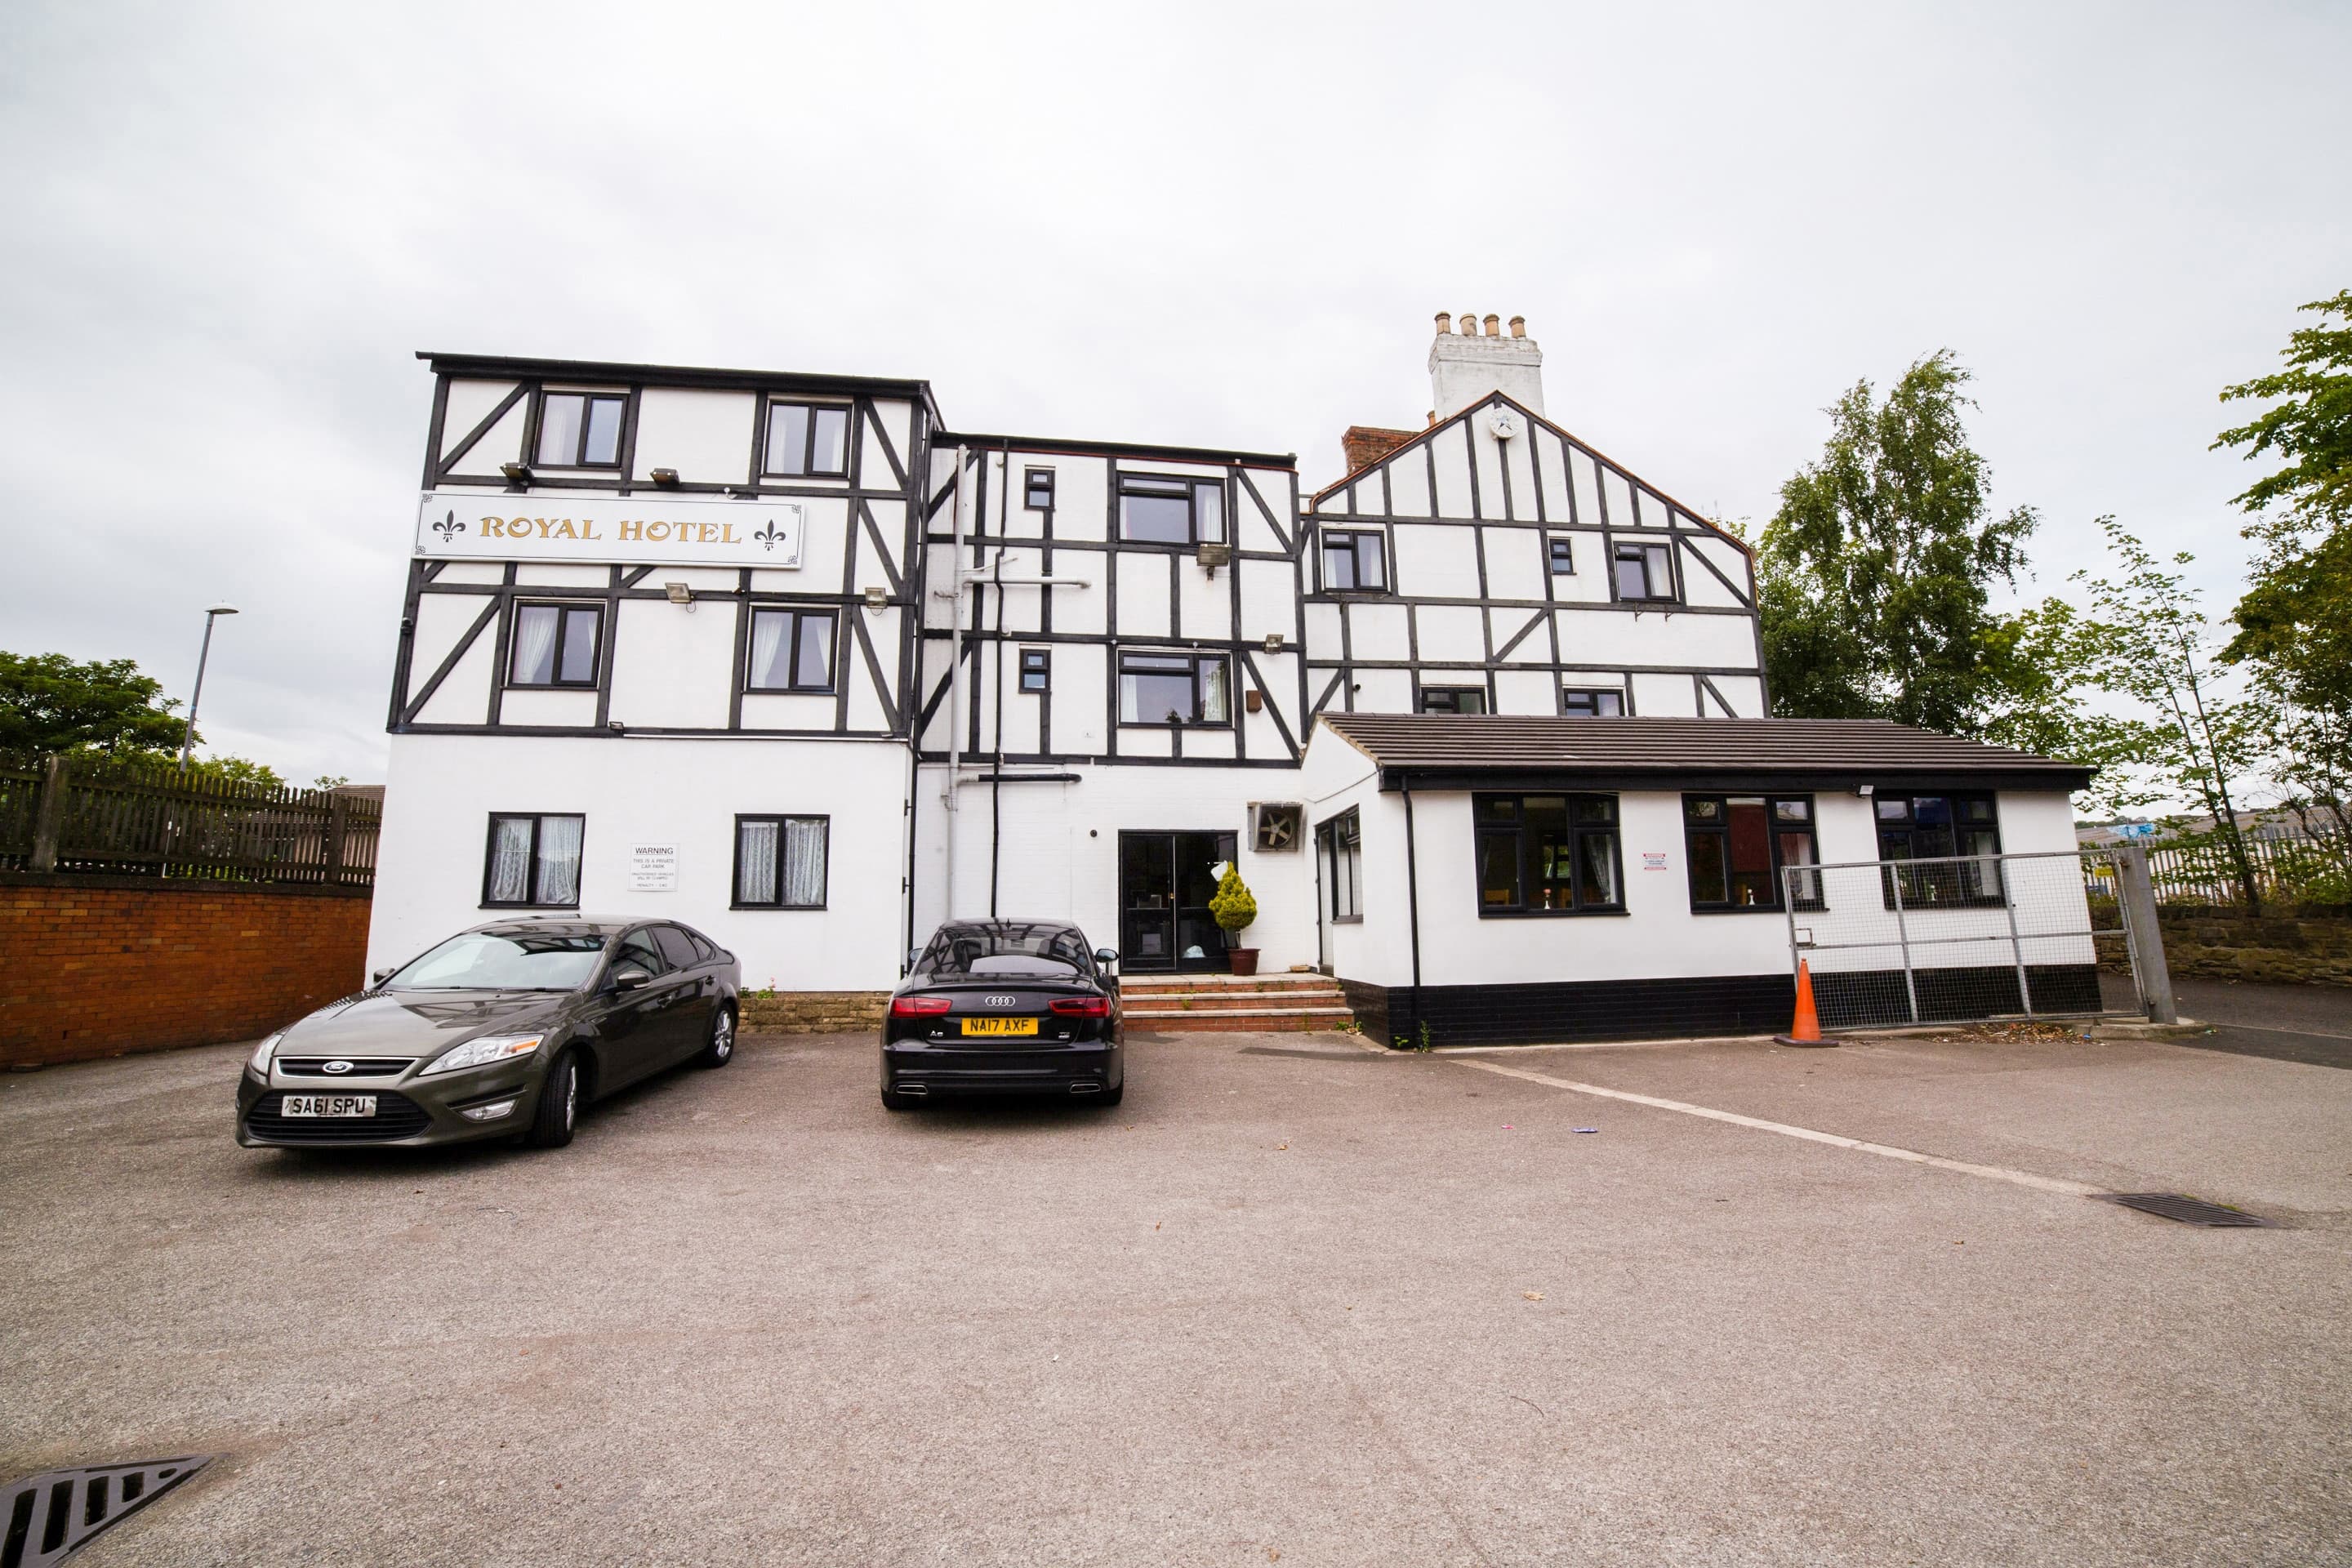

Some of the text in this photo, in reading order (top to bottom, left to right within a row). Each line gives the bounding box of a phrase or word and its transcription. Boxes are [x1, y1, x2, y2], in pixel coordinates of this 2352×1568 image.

[479, 516, 742, 544] ROYAL HOTEL
[970, 1019, 1029, 1031] NA17 AXF
[292, 1098, 366, 1114] SA61 SPU
